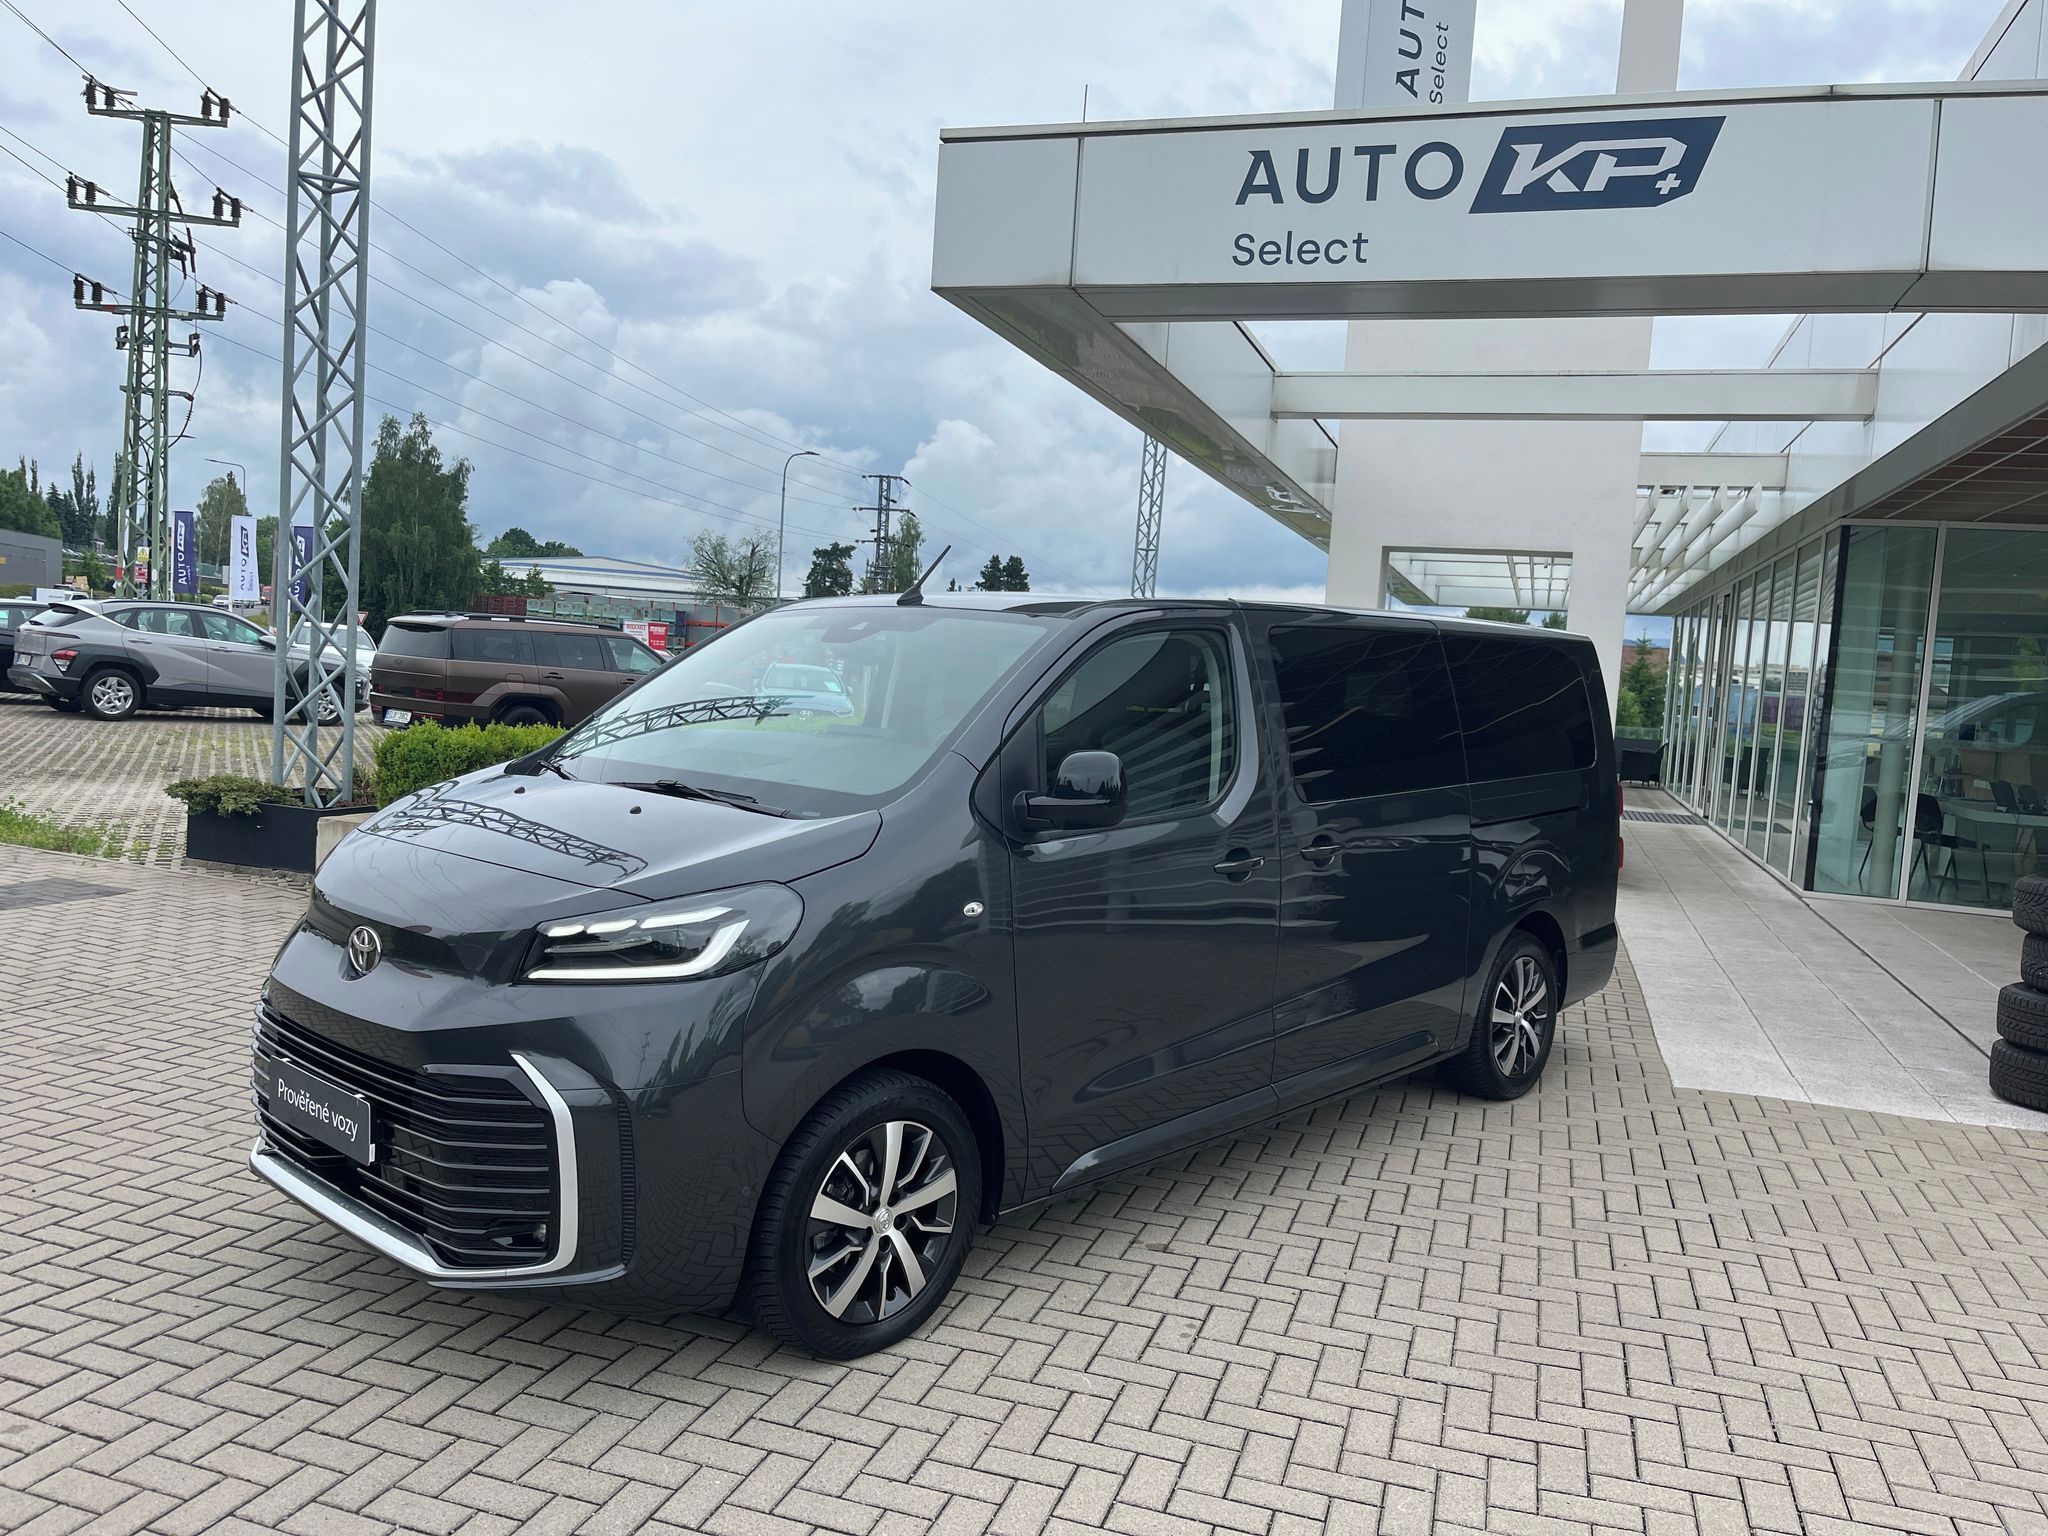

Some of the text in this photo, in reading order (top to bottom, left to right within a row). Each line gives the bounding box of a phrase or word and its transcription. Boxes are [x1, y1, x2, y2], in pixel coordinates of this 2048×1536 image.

[1395, 0, 1425, 99] AUT
[1429, 21, 1449, 104] Select
[1235, 140, 1465, 206] AUTO
[1232, 230, 1369, 267] Select
[178, 552, 188, 585] AUTO
[240, 558, 248, 591] AUTO
[277, 1078, 358, 1142] Prověřené vozy
